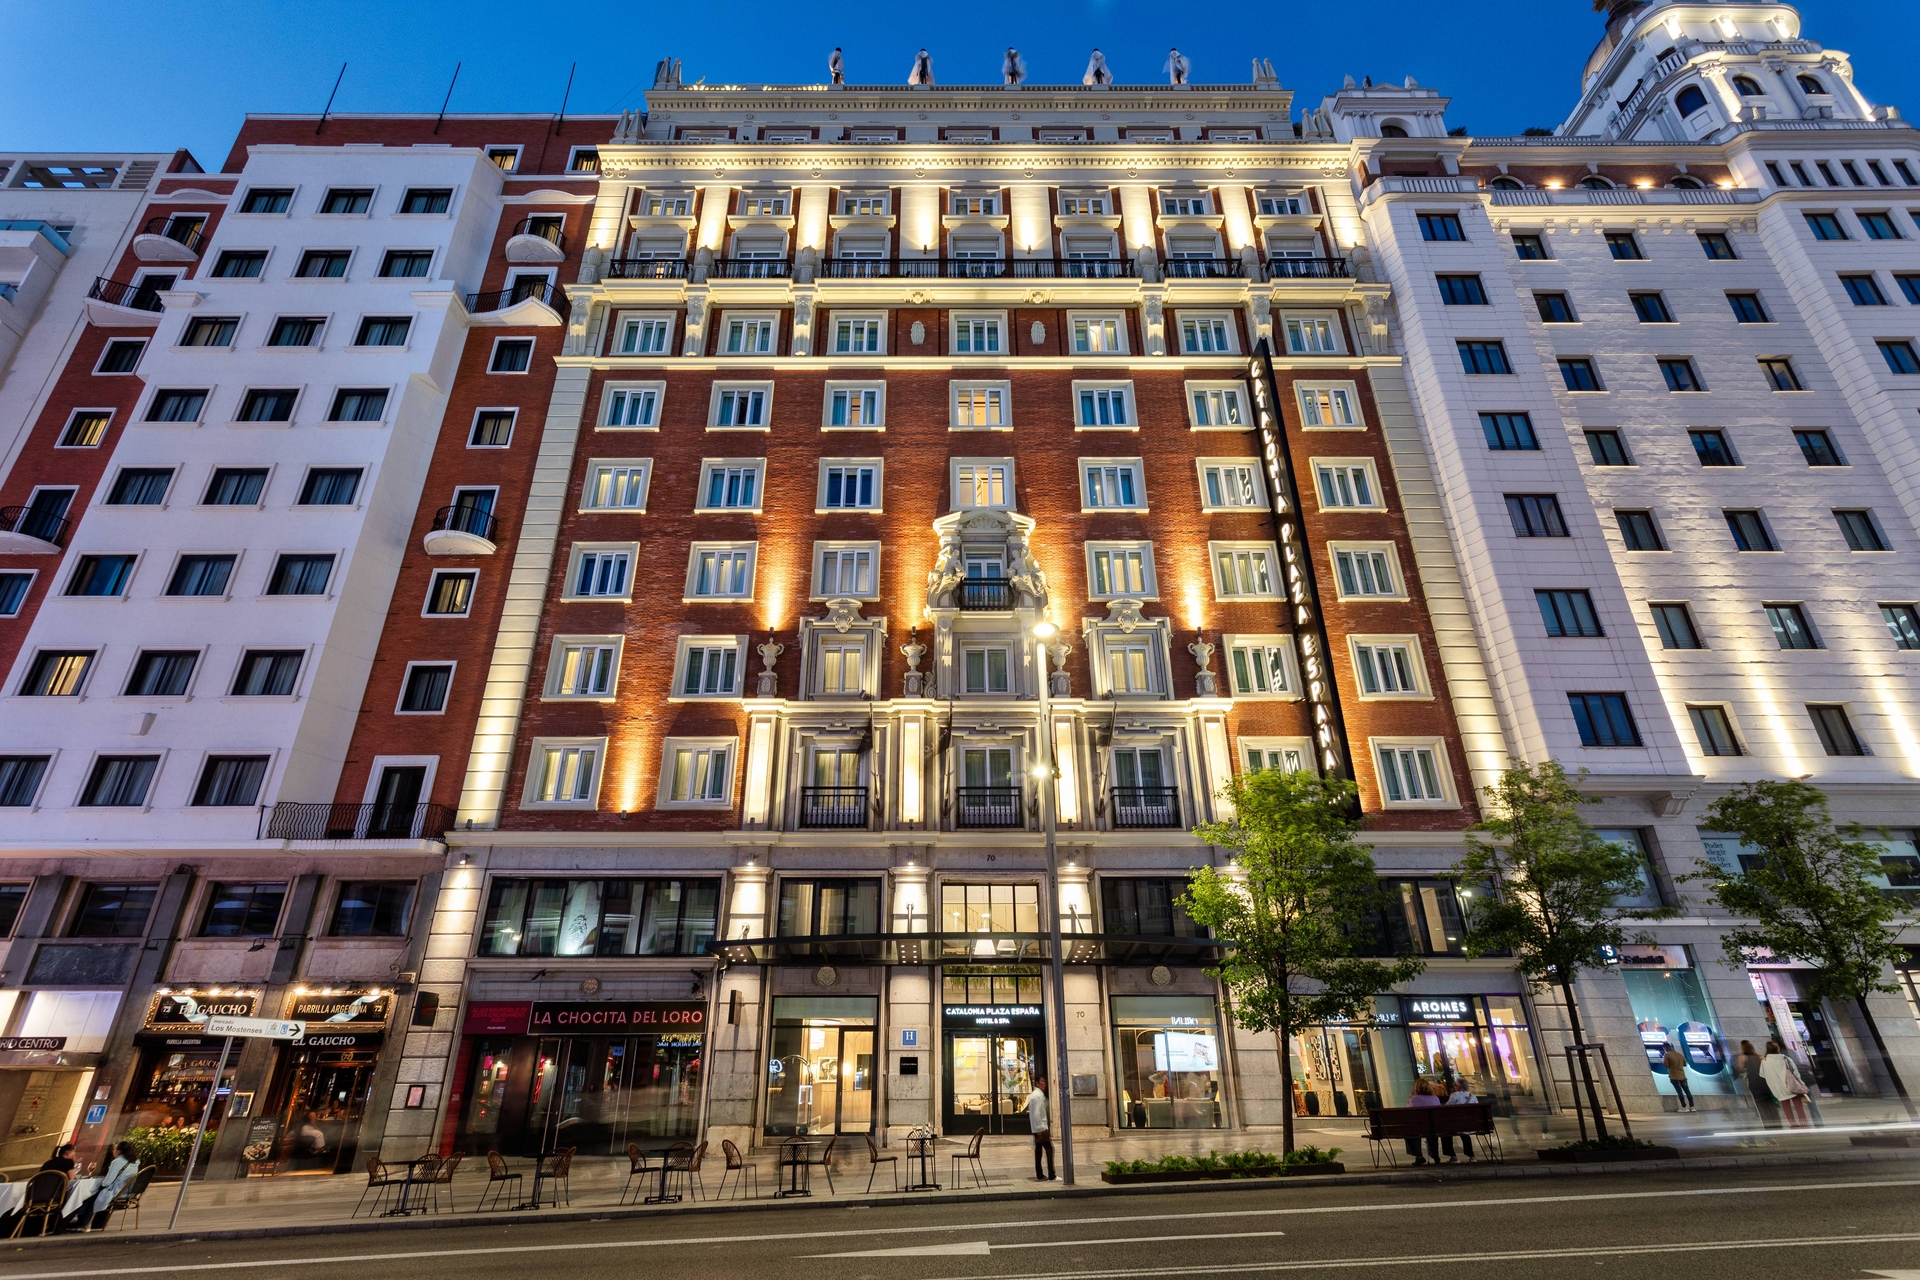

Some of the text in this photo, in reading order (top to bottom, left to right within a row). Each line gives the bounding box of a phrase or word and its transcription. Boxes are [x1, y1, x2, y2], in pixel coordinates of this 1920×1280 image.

[1252, 361, 1339, 770] CATALONIA PLAZA ESPAÑA
[1706, 848, 1726, 856] elegir
[986, 854, 996, 862] 70
[178, 1004, 247, 1015] EL GAUCHO
[297, 1004, 367, 1014] PARRILLA ARGENTINA
[1011, 1006, 1040, 1015] ESPAÑA
[1413, 1001, 1467, 1012] AROMES
[534, 1010, 703, 1024] LA CHOCITA DEL LORO
[225, 1025, 262, 1034] Mostenses
[906, 1031, 914, 1040] H
[18, 1038, 59, 1049] CENTRO
[292, 1036, 356, 1046] EL GAUCHO
